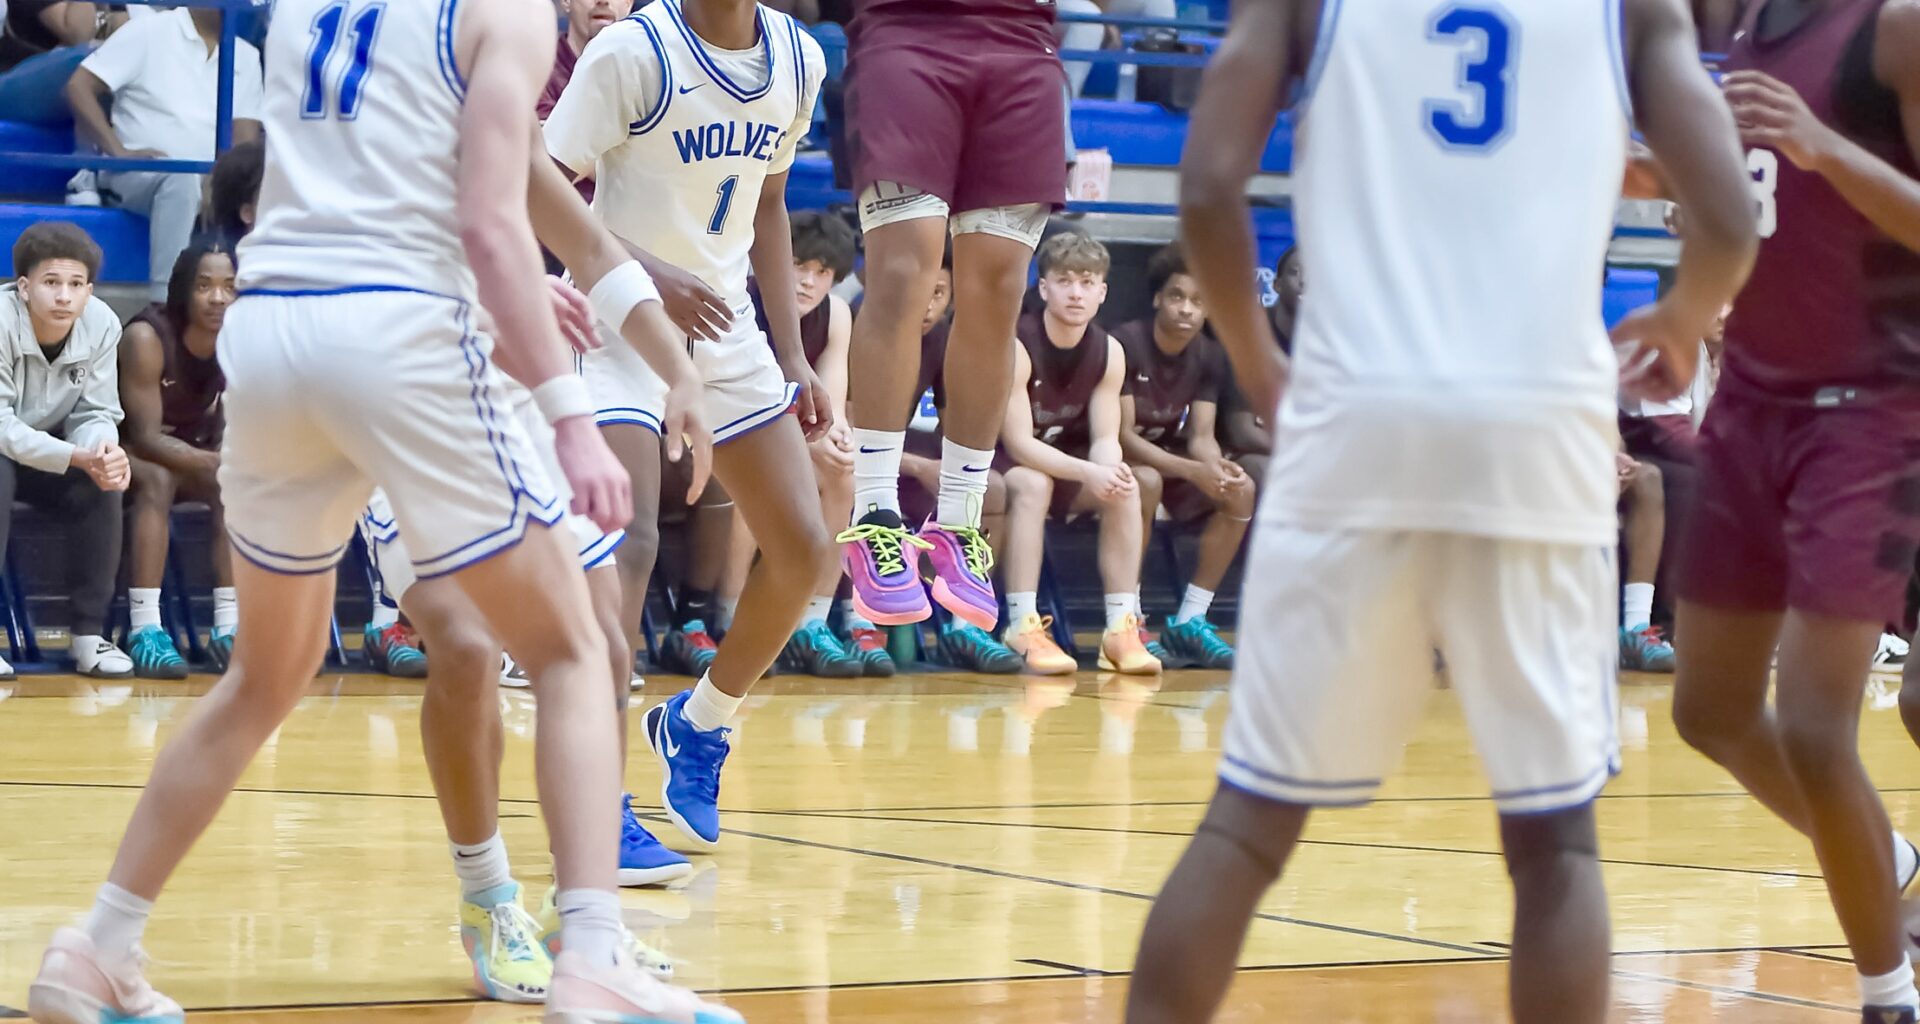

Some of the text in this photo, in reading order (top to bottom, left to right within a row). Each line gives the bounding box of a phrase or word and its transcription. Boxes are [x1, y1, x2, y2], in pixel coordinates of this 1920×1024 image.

[300, 0, 387, 121] 11
[1421, 1, 1521, 155] 3
[707, 174, 739, 235] 1
